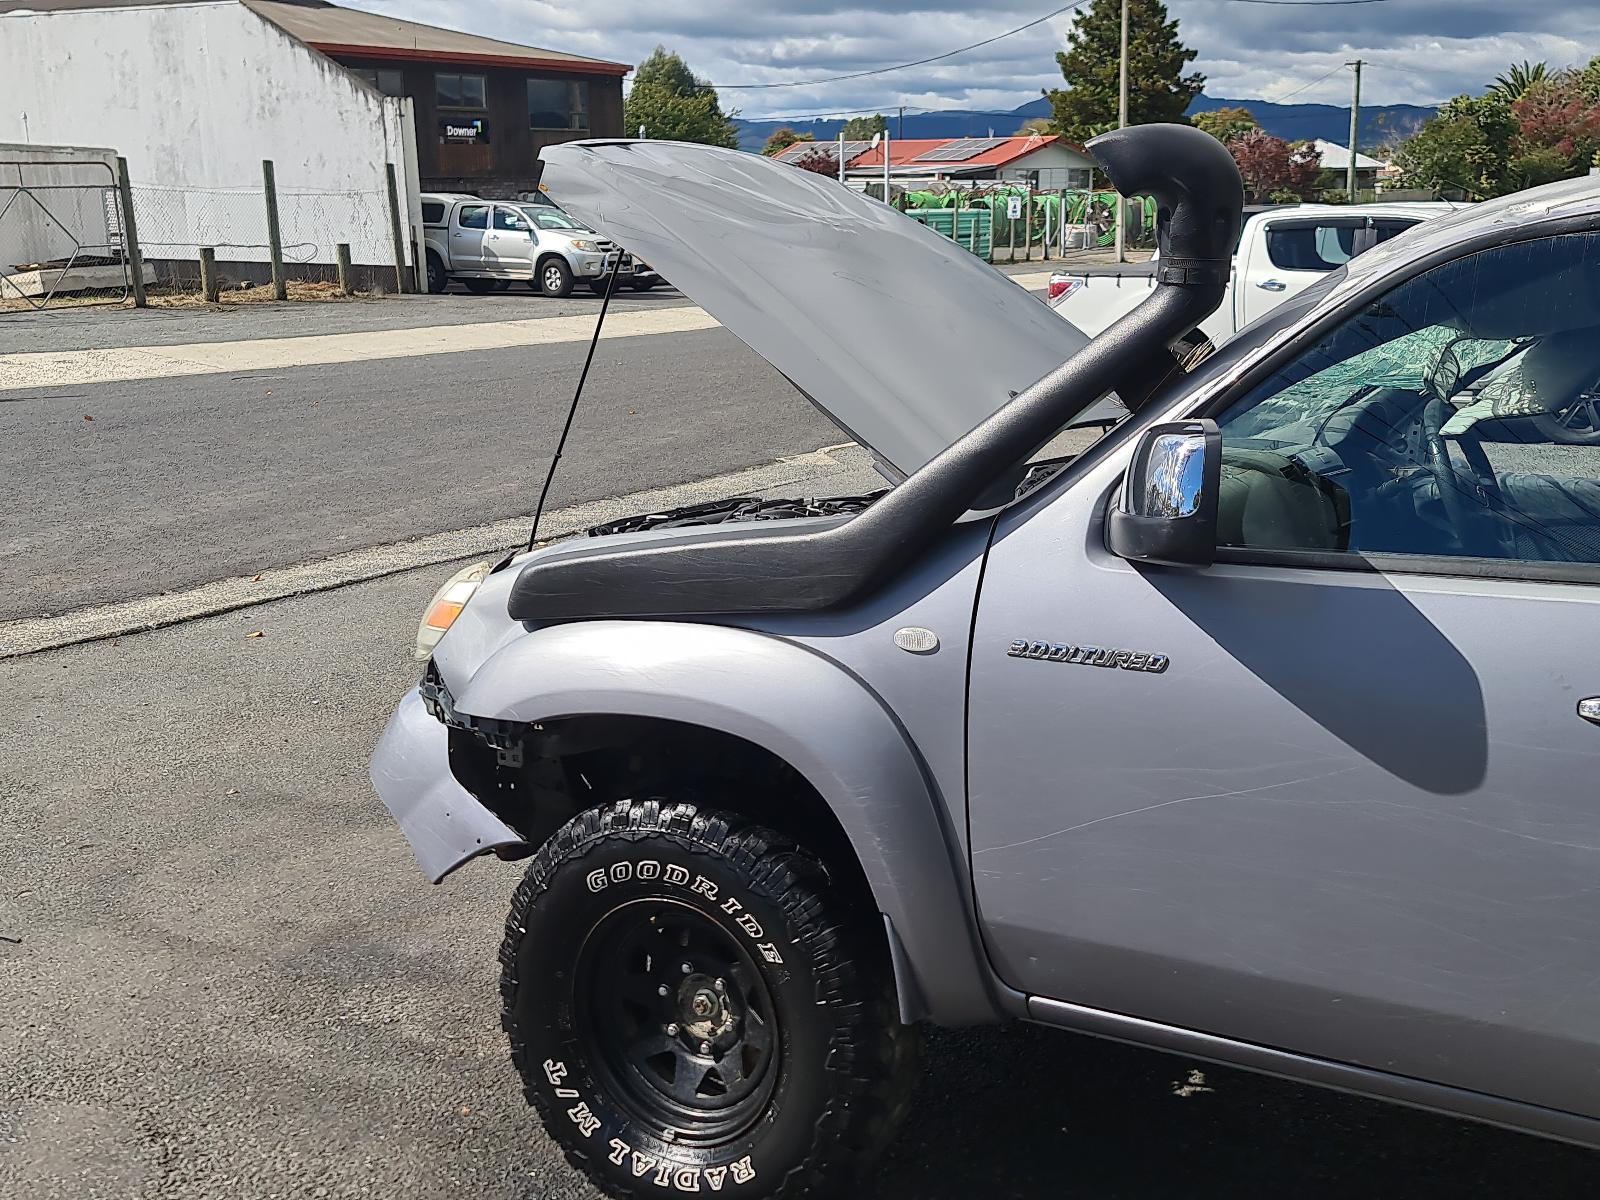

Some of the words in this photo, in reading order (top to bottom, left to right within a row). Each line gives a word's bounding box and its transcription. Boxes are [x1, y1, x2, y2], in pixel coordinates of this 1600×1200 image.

[446, 125, 477, 137] Downer
[586, 860, 784, 965] GOODRIDE
[542, 1057, 602, 1138] M/T
[608, 1136, 756, 1194] RADIAL
